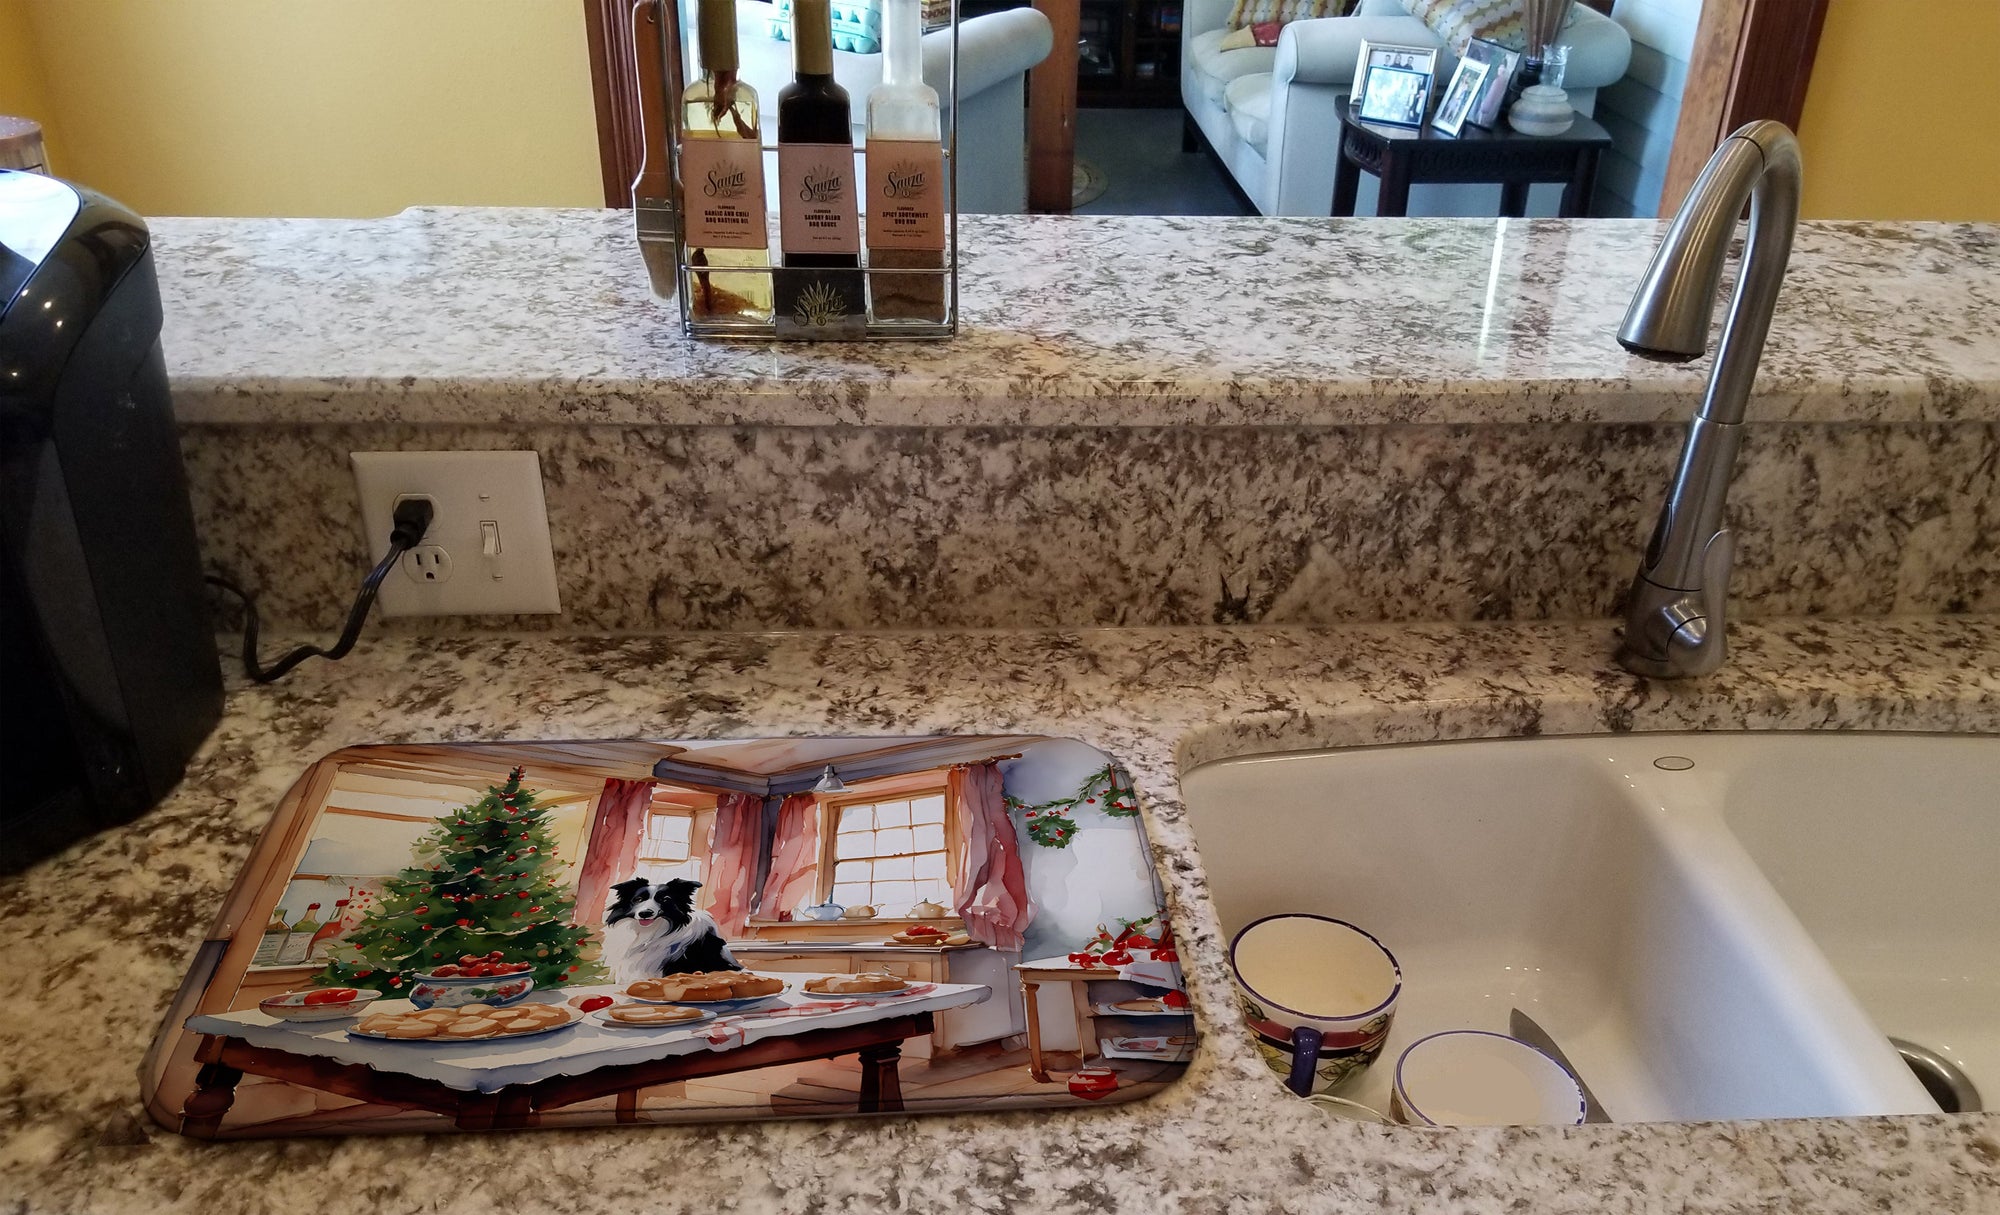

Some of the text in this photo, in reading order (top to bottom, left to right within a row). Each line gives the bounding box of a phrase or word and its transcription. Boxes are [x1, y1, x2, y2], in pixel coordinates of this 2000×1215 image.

[704, 170, 745, 197] Sauza
[800, 175, 841, 202] Sauza
[884, 171, 924, 198] Sauza
[793, 295, 845, 327] Sauza
